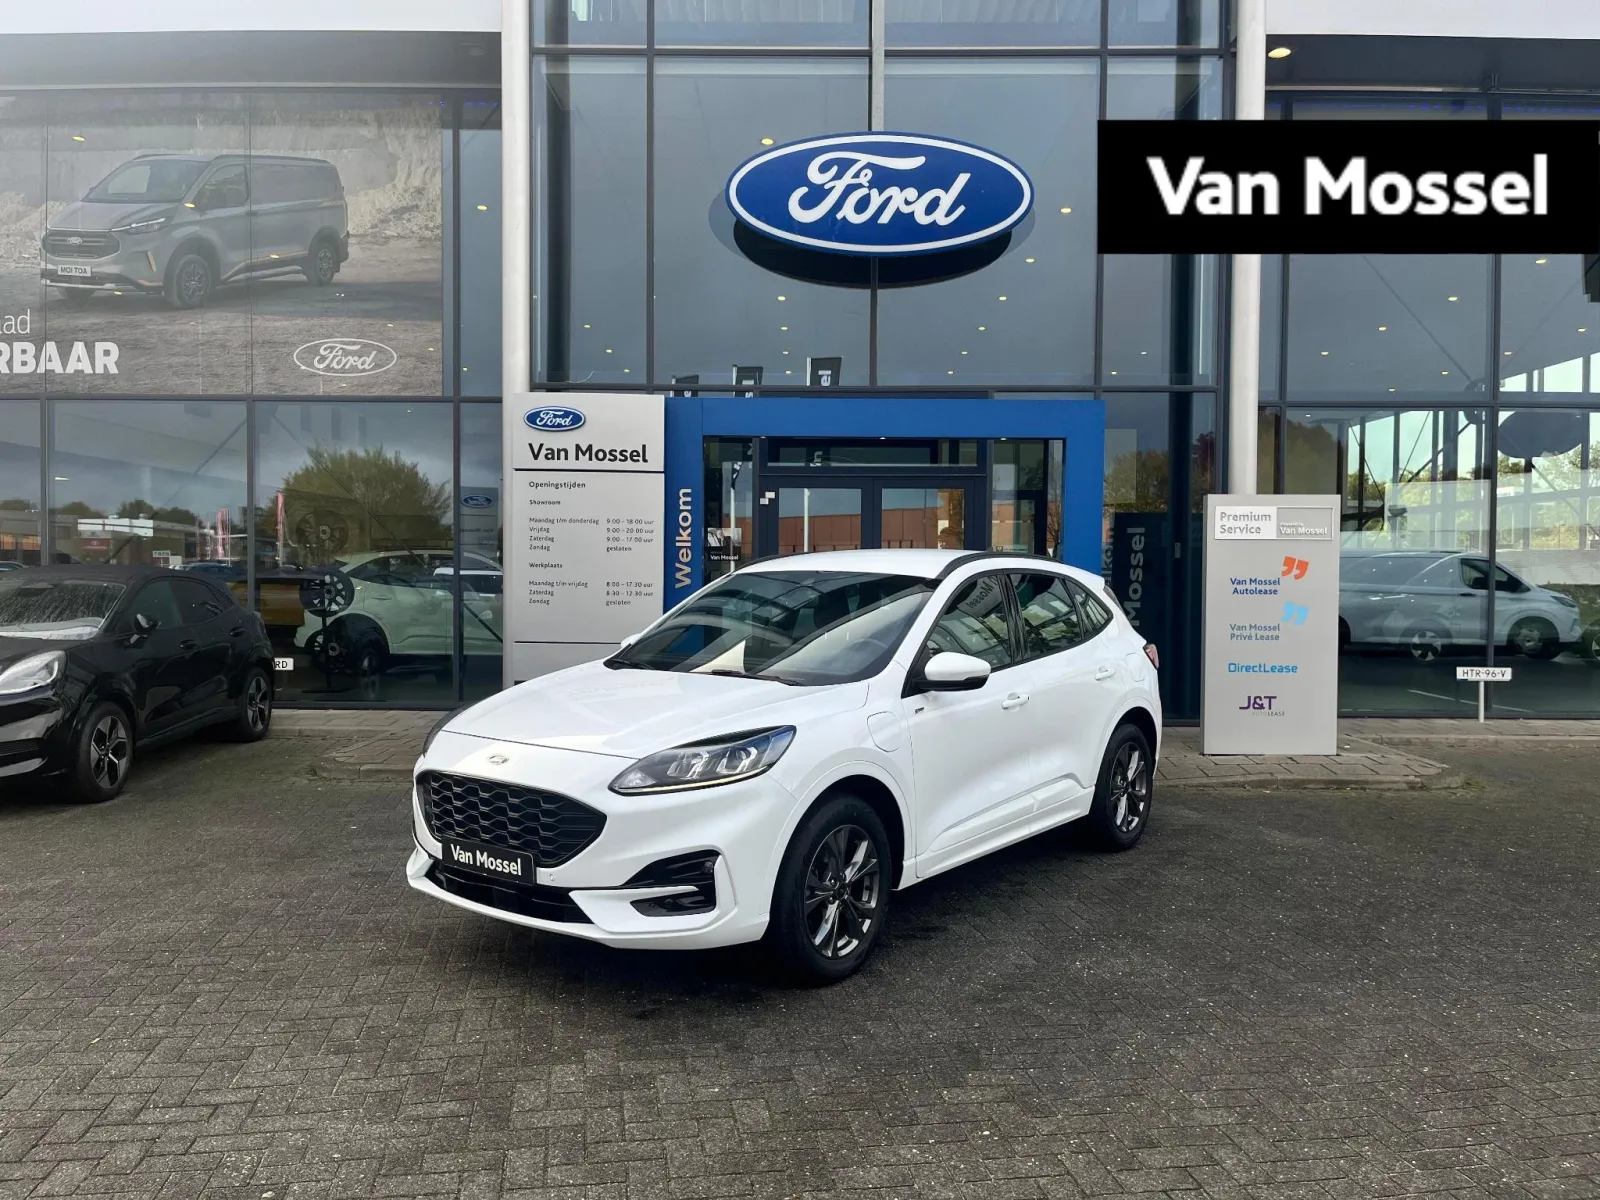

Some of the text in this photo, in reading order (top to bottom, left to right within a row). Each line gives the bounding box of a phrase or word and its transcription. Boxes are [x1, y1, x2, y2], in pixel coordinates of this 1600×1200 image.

[788, 151, 971, 226] Ford
[0, 308, 31, 334] ad
[313, 343, 378, 370] Ford
[535, 410, 573, 427] Ford
[528, 442, 649, 463] Van Mossel
[528, 481, 586, 489] Openingstijden
[1219, 512, 1272, 522] Premium
[529, 526, 550, 534] Vrijdag
[1219, 524, 1262, 534] Service
[1280, 526, 1328, 535] Van Mossel
[529, 535, 555, 543] Zaterdag
[675, 488, 692, 589] Welkom
[1123, 527, 1146, 627] Mossel
[1229, 577, 1281, 586] Van Mossel
[528, 589, 554, 597] Zaterdag
[1232, 586, 1278, 595] Autolease
[1229, 623, 1281, 632] Van Mossel
[1230, 632, 1280, 641] Privé Lease
[1228, 662, 1298, 673] DirectLease
[1462, 668, 1507, 678] HTR-96-V
[1239, 695, 1278, 711] J&T
[450, 843, 522, 876] Van Mossel
